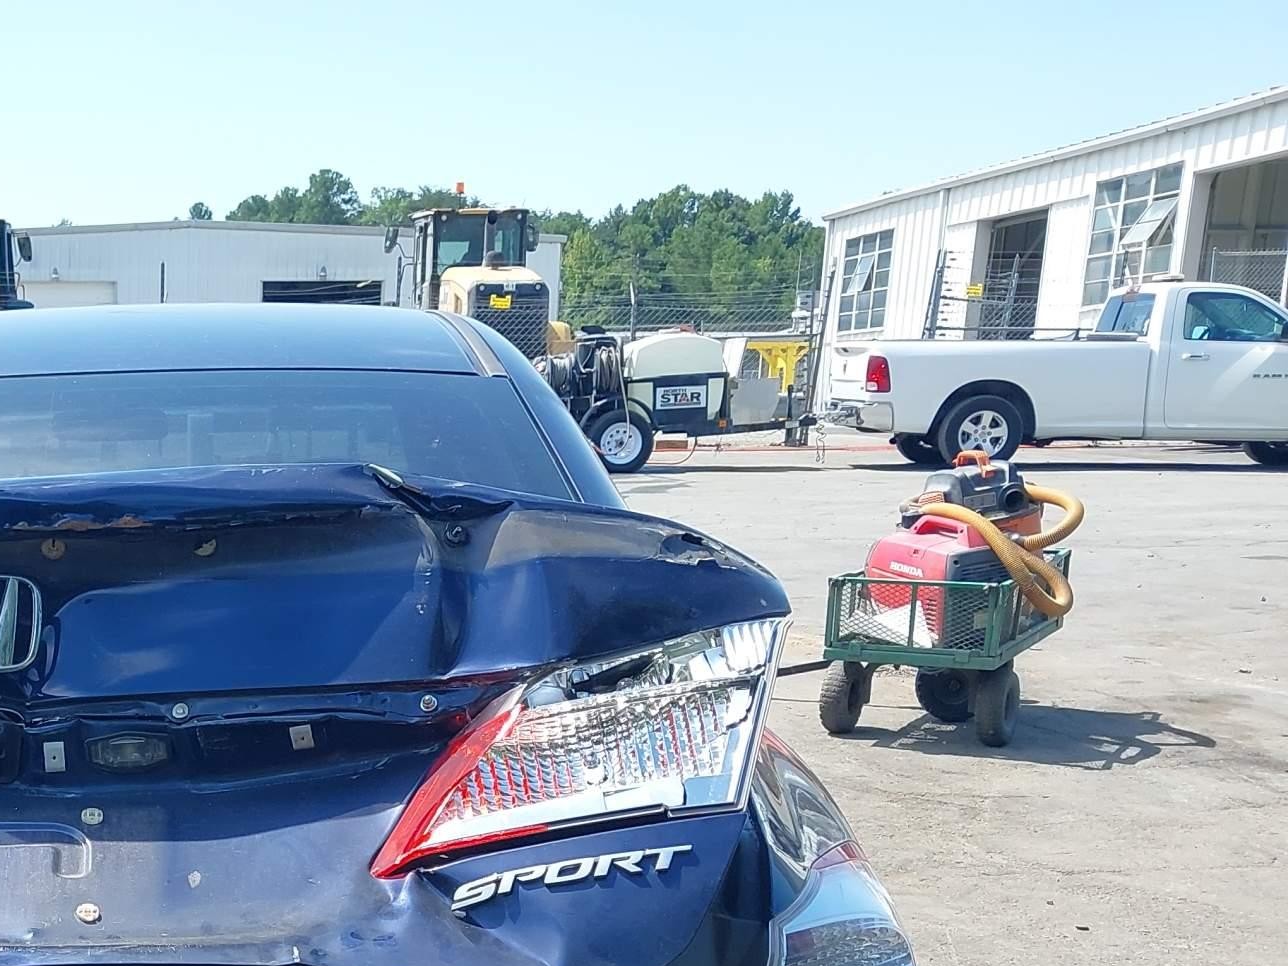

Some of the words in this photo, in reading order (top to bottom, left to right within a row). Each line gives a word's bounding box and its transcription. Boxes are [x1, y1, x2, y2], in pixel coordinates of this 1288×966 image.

[660, 392, 702, 403] STAR
[889, 560, 924, 578] HONDA
[450, 844, 693, 911] SPORT
